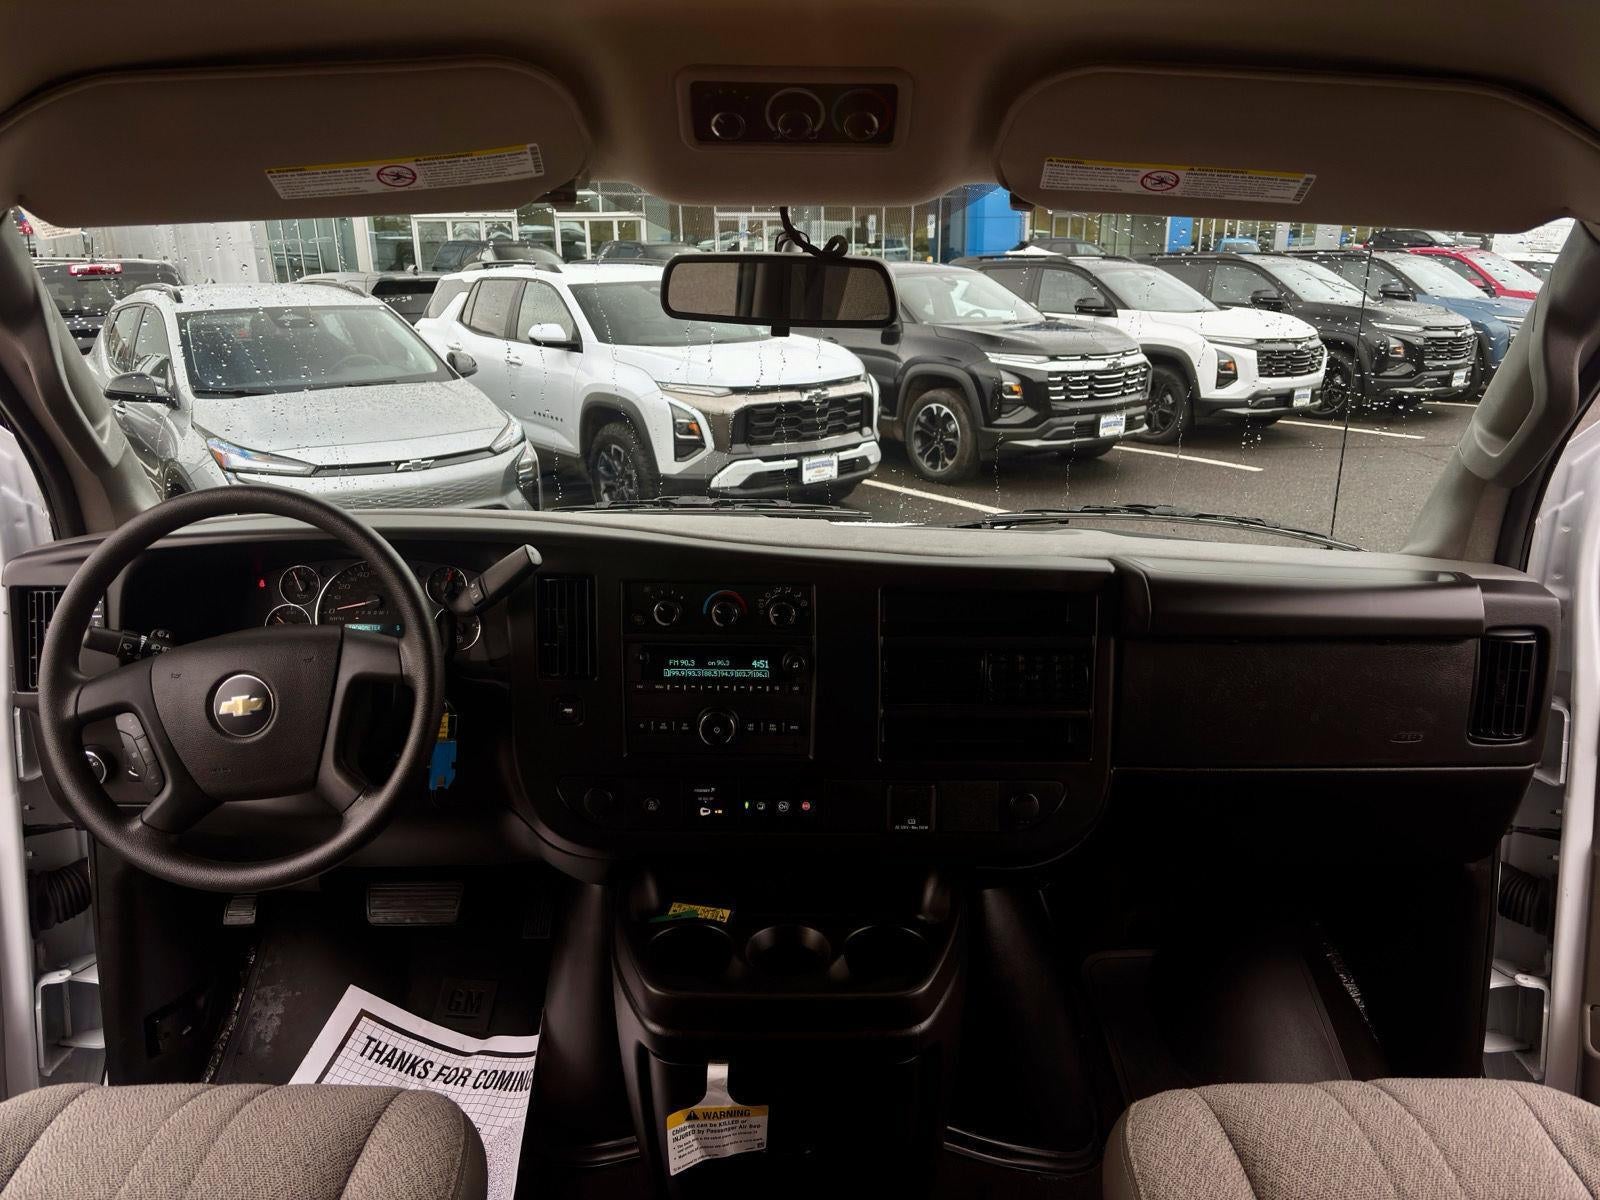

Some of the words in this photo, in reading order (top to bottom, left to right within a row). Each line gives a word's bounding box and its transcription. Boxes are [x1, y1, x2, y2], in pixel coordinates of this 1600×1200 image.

[752, 660, 769, 669] 4:51
[447, 988, 484, 1014] GM
[359, 1035, 434, 1080] THANKS
[432, 1065, 472, 1088] FOR
[702, 1109, 751, 1120] WARNING
[672, 1123, 695, 1136] Children
